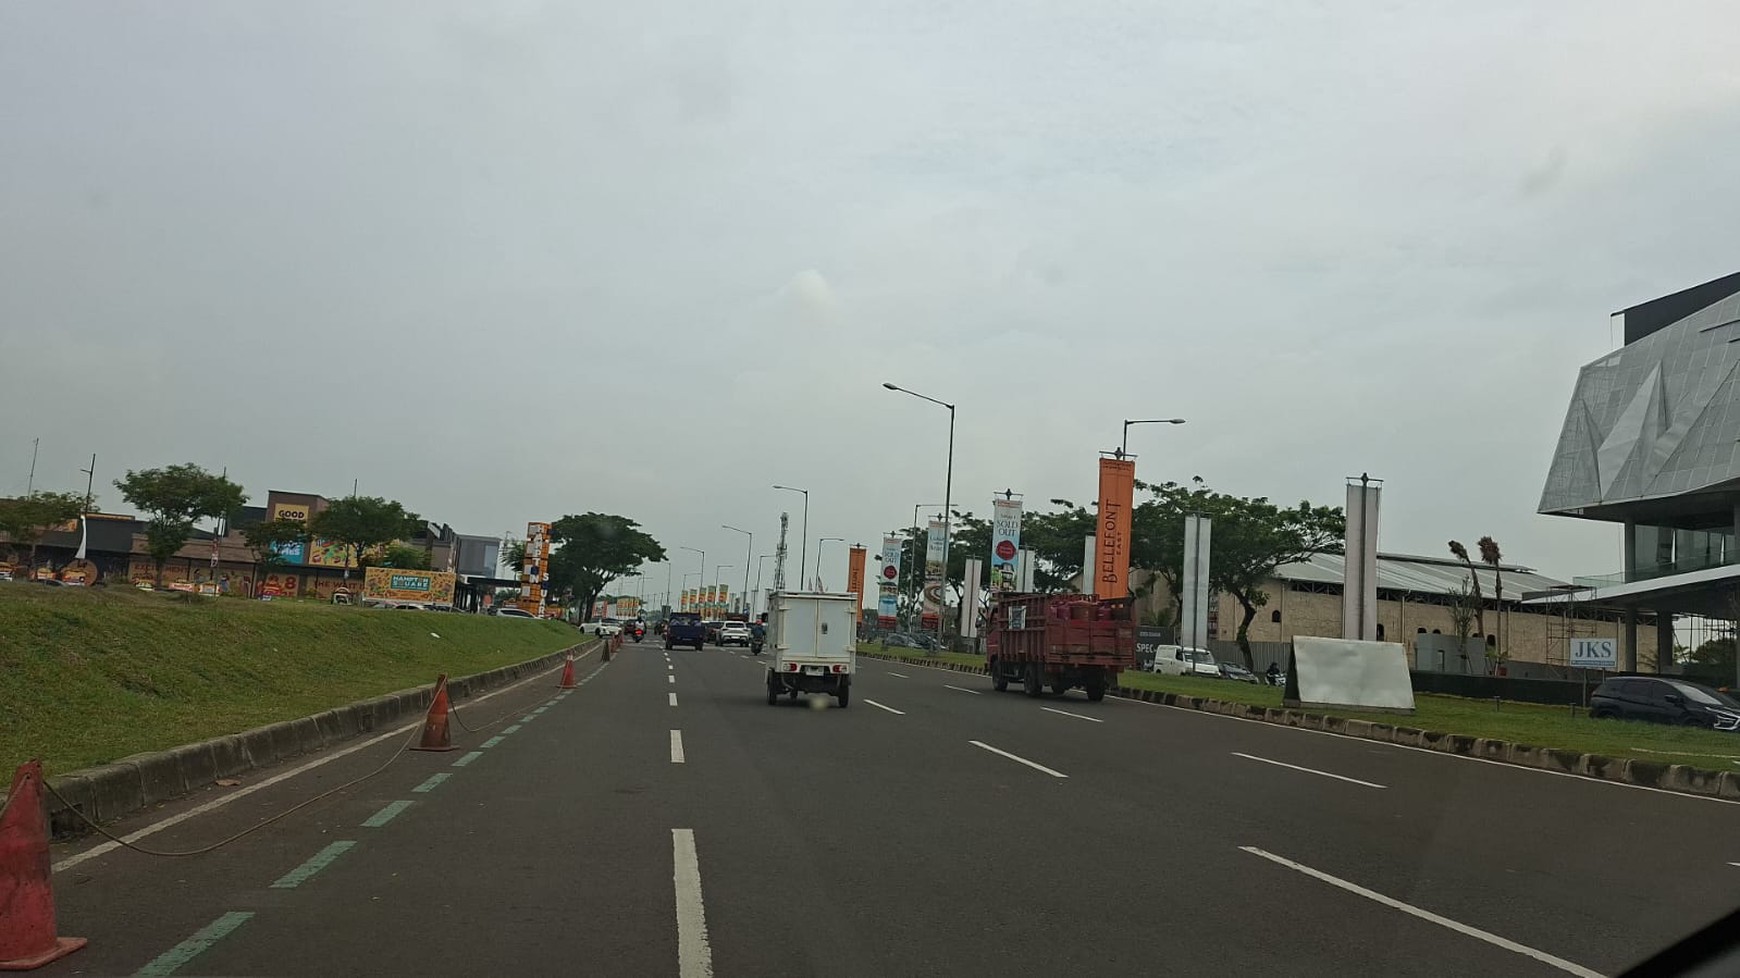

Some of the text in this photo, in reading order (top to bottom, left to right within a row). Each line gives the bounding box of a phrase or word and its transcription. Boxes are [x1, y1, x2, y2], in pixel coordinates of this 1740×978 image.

[278, 509, 305, 519] GOOD
[996, 520, 1018, 529] SOLD
[998, 528, 1017, 537] OUT
[1102, 499, 1122, 584] BELLEFONT
[1575, 641, 1612, 658] JKS
